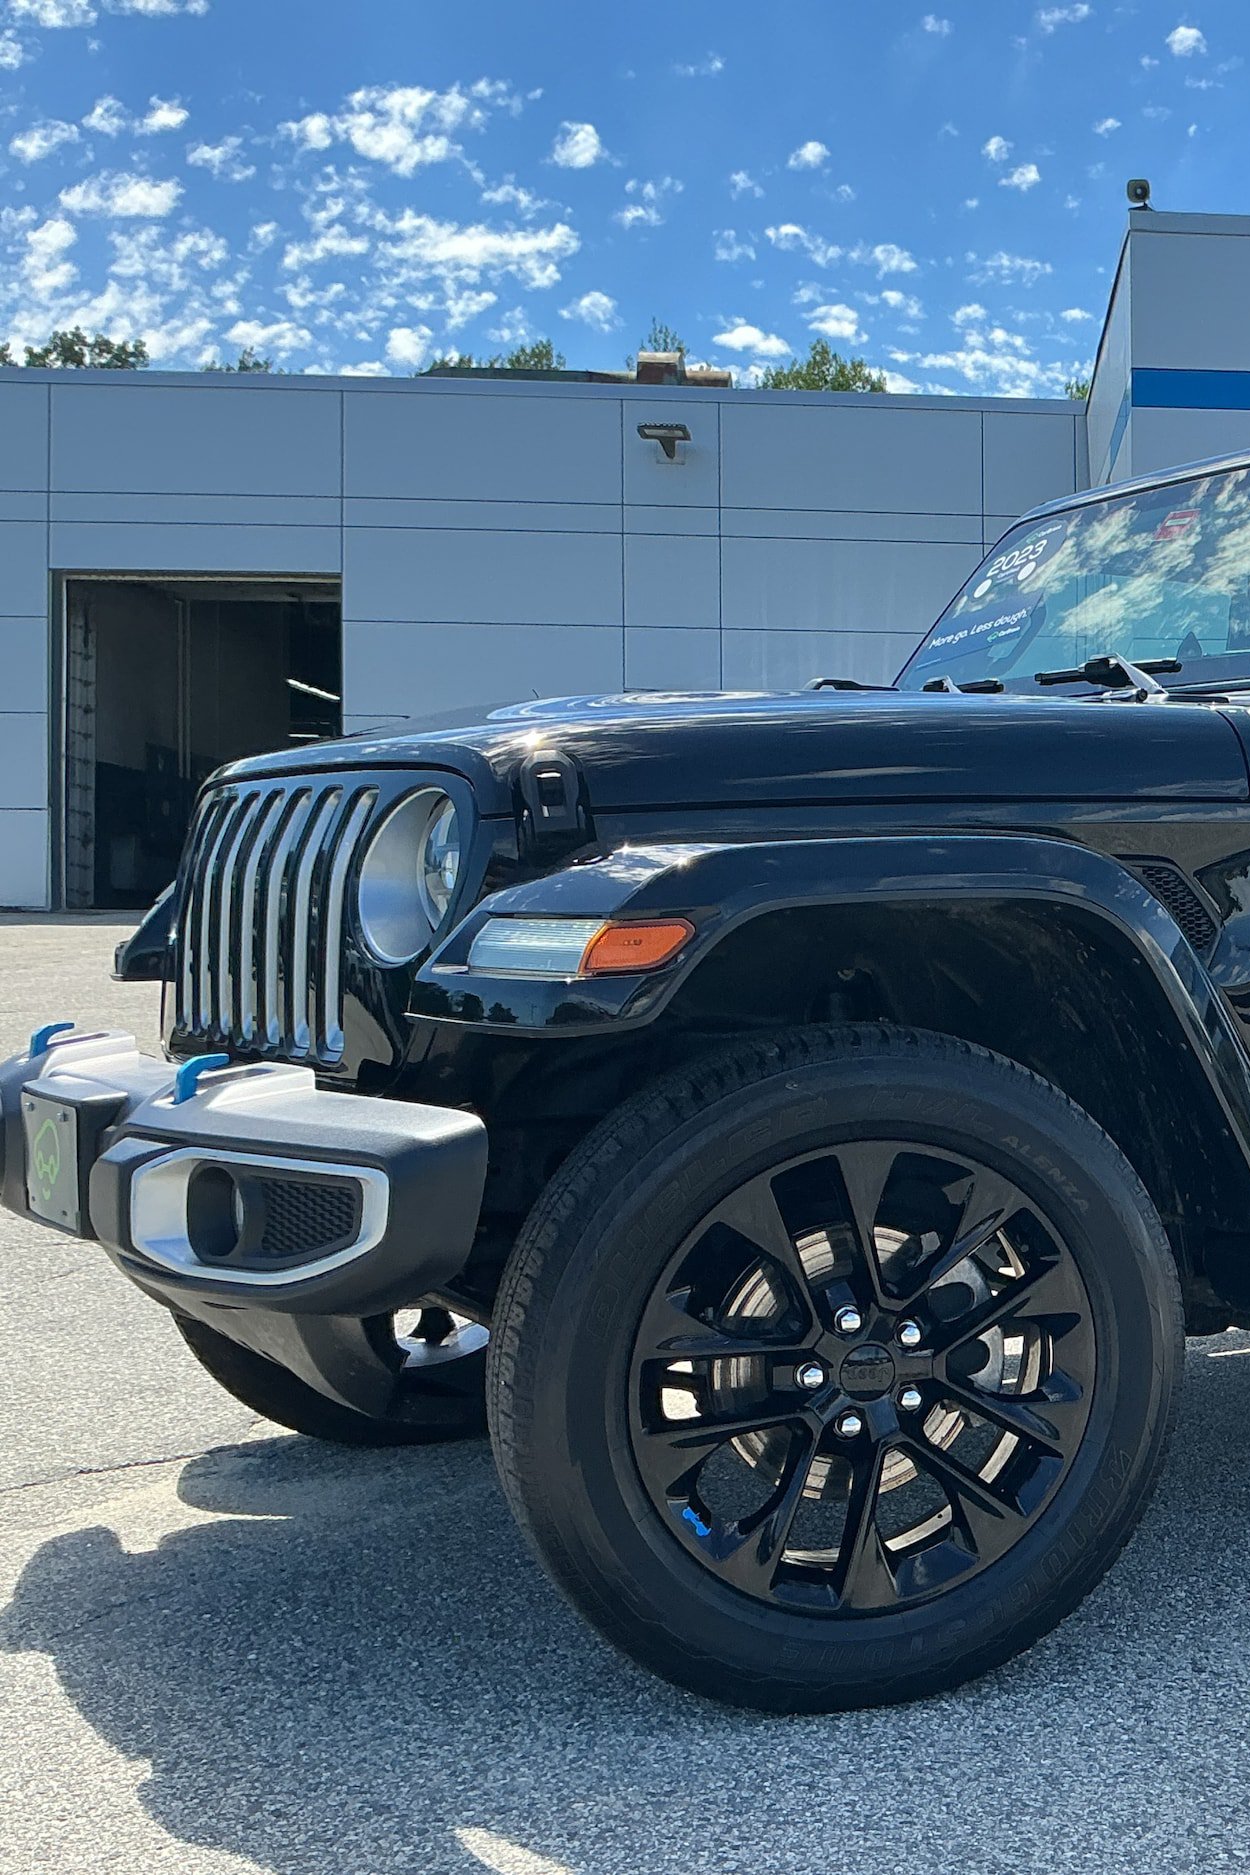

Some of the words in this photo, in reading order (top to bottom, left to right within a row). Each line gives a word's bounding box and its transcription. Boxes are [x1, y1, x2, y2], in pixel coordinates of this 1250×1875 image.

[986, 538, 1048, 578] 2023
[929, 632, 955, 650] More
[970, 620, 995, 636] Less
[1001, 1134, 1088, 1217] ALENZA
